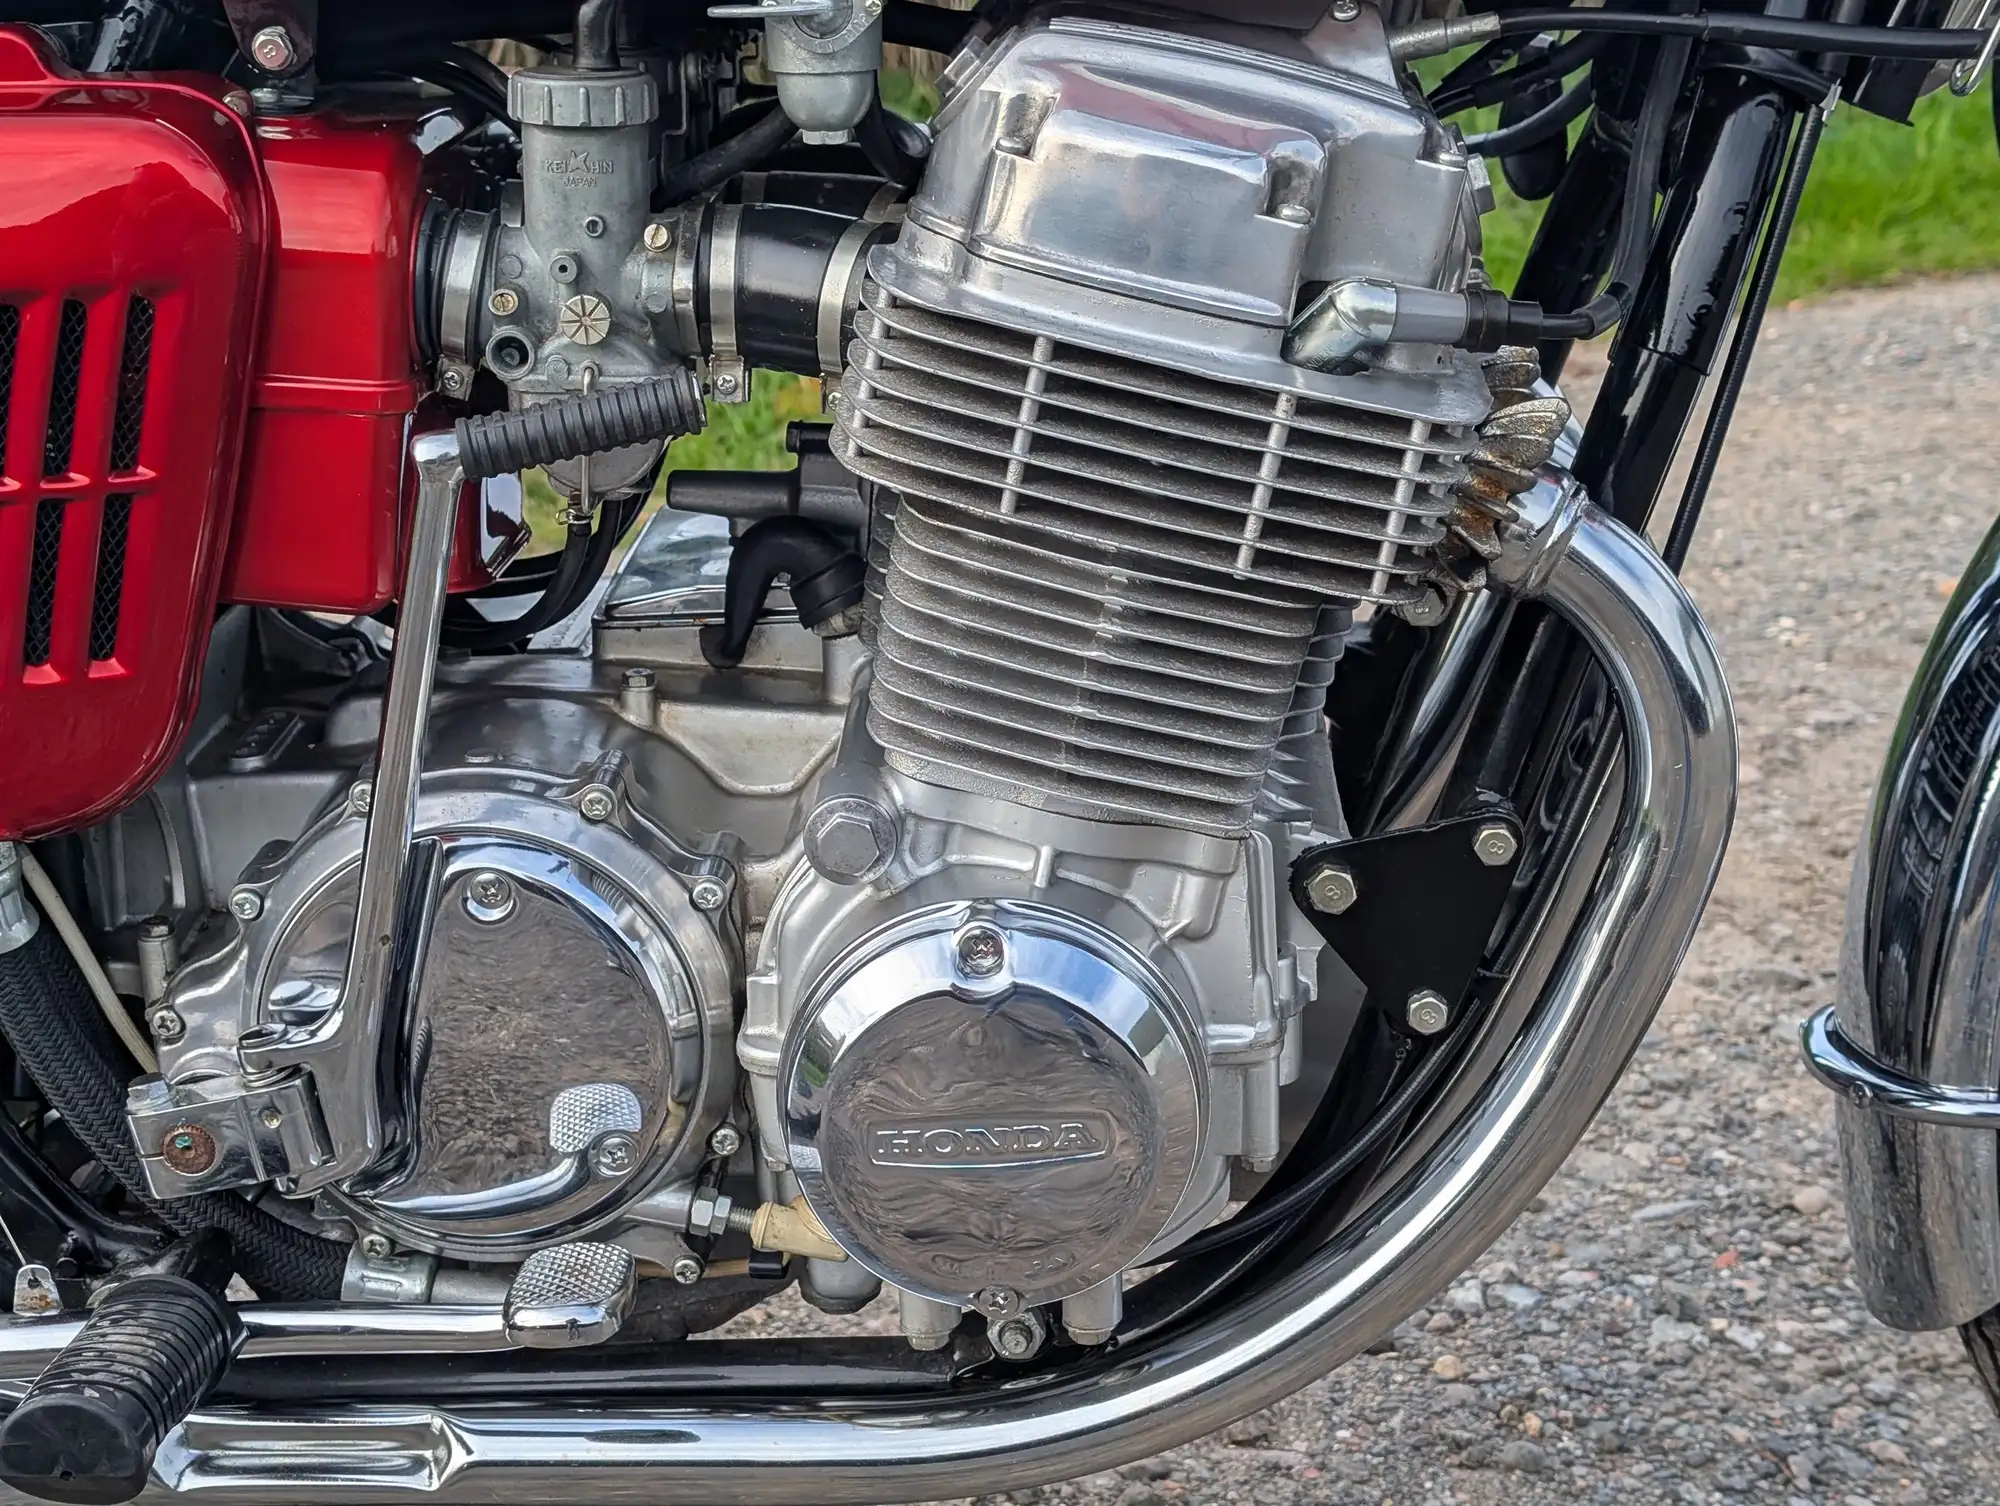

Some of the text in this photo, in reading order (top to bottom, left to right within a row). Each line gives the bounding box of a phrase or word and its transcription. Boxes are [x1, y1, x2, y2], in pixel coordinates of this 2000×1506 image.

[563, 176, 597, 187] JAPAN
[1487, 839, 1506, 855] 8
[1420, 1008, 1439, 1025] 8
[876, 1123, 1100, 1157] HONDA
